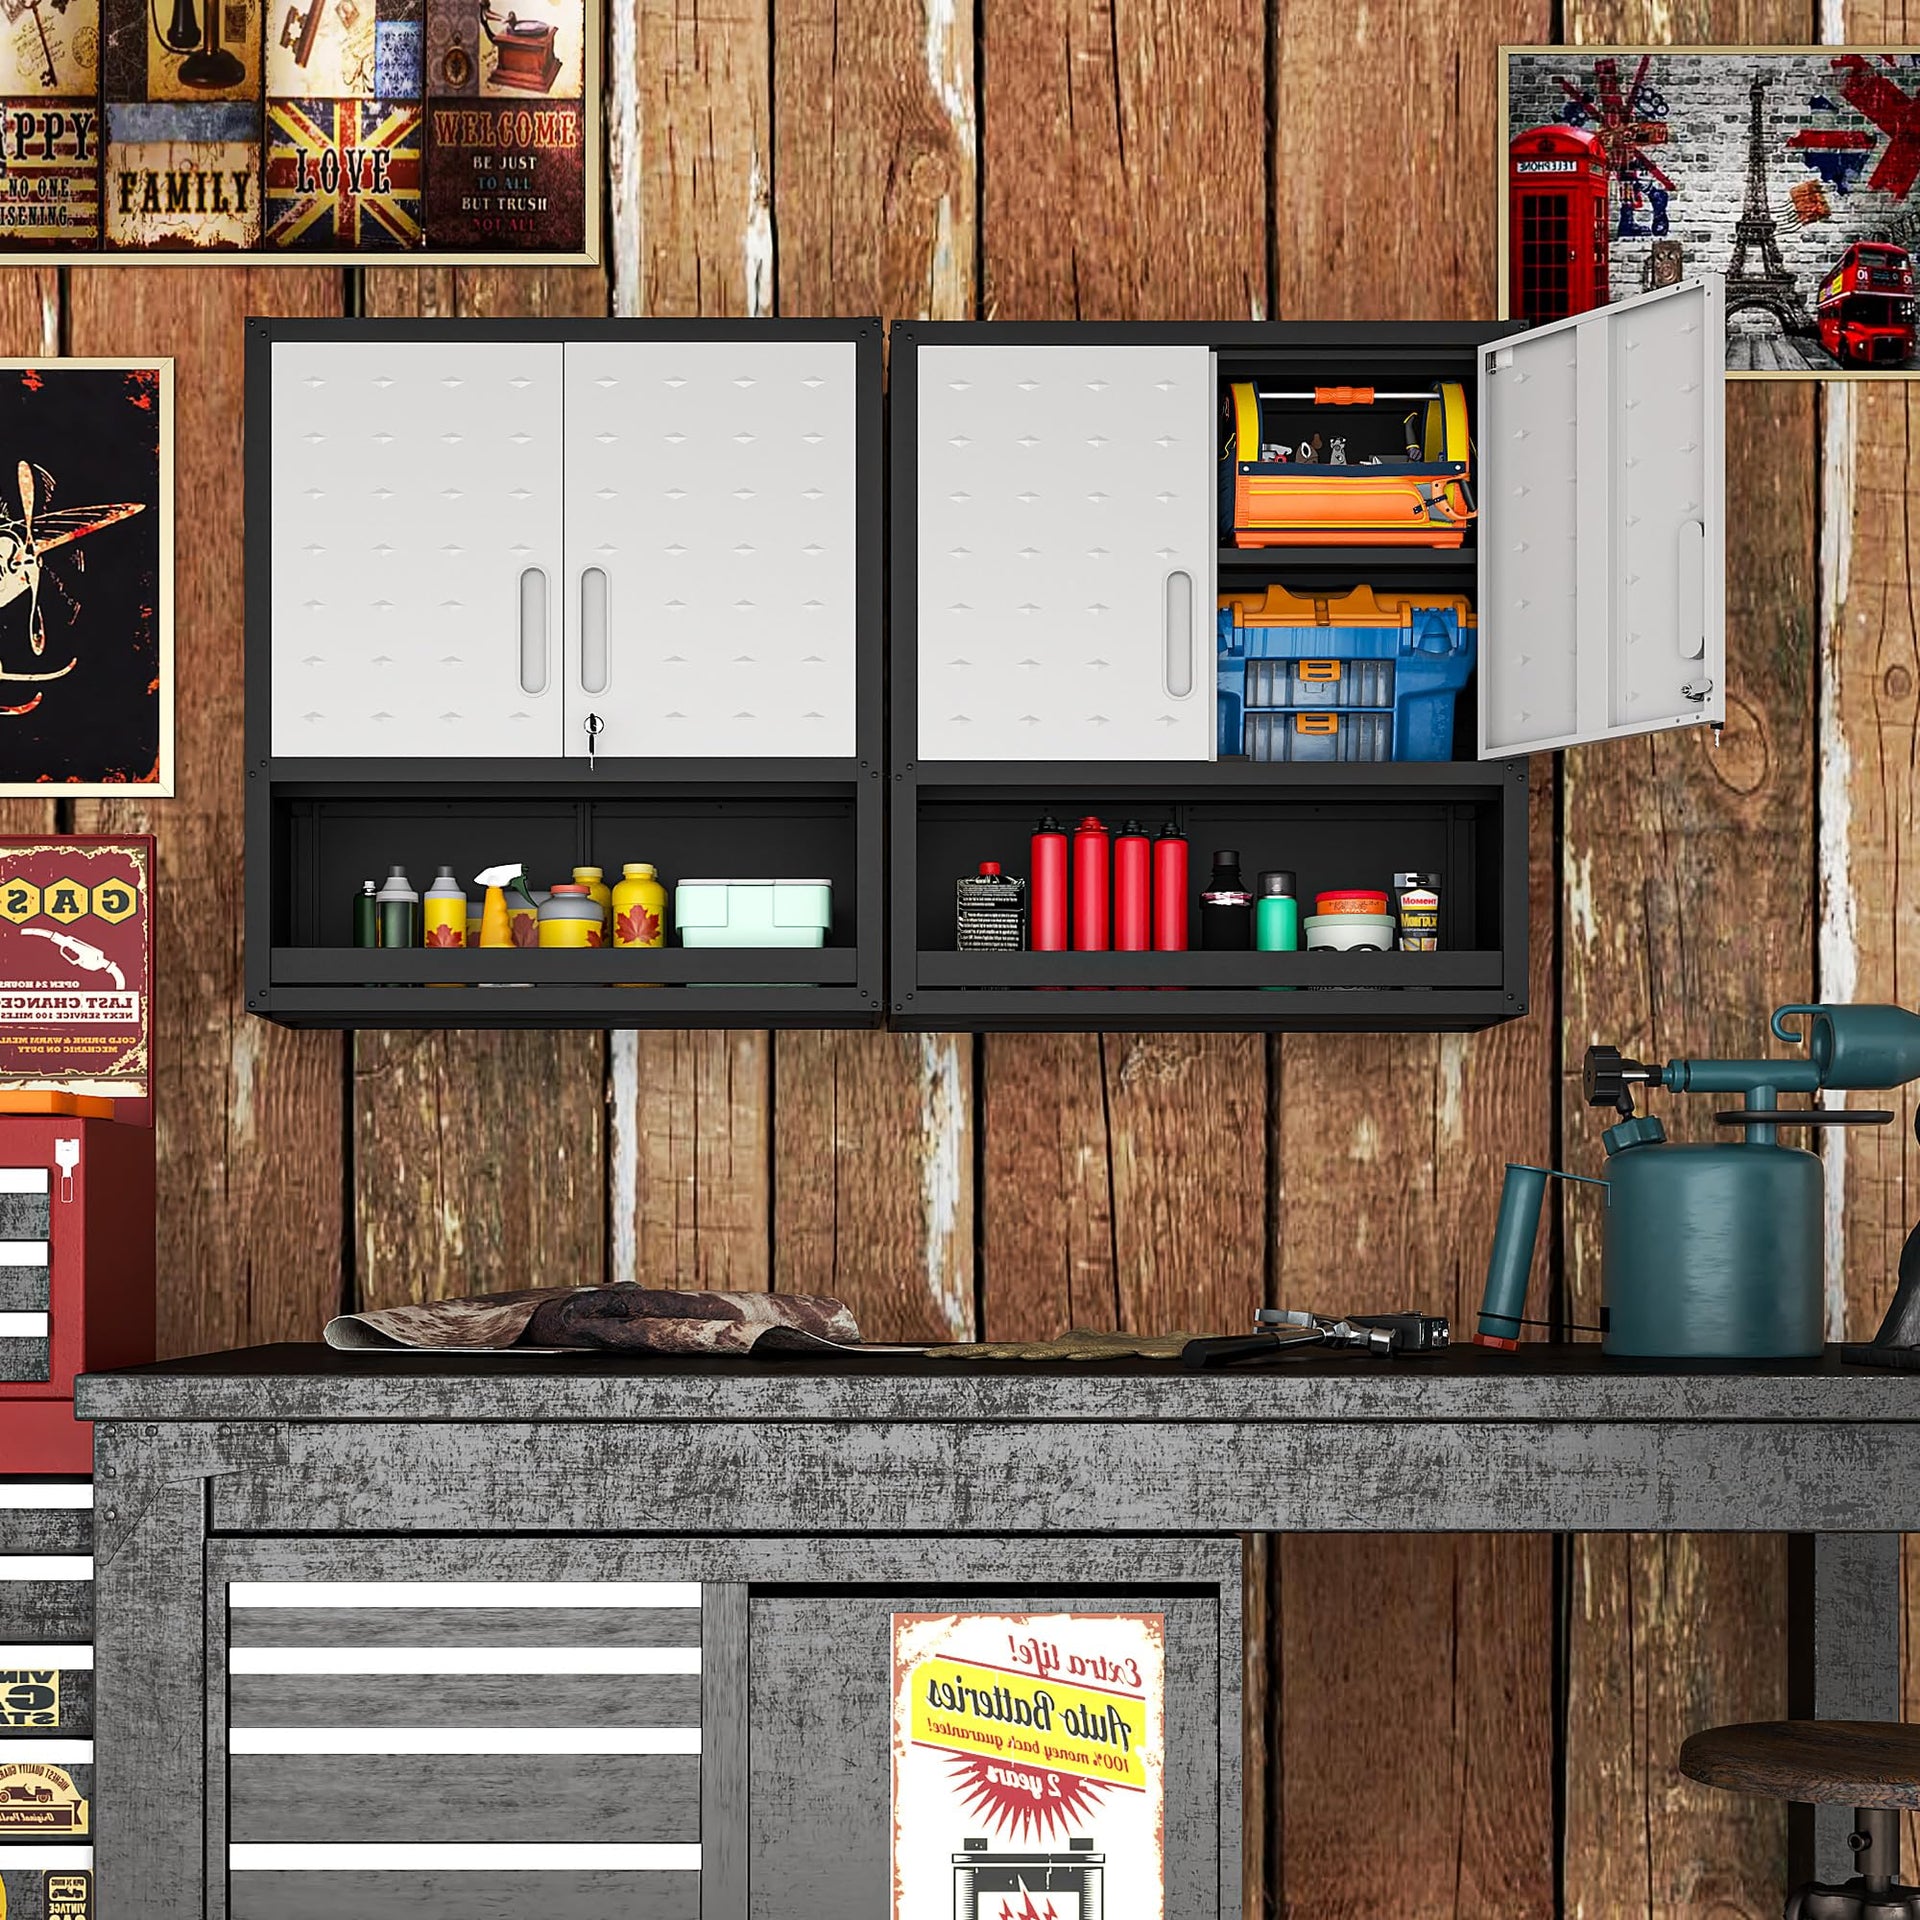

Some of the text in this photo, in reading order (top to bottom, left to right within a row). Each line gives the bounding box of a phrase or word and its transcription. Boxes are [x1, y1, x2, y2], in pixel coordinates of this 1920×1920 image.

[0, 112, 94, 161] PPY
[434, 111, 577, 148] WELCOME
[294, 147, 391, 195] LOVE
[473, 156, 537, 170] BE JUST
[8, 178, 29, 198] NO
[118, 170, 250, 214] FAMILY
[478, 176, 531, 190] TO ALL
[461, 197, 490, 211] BUT
[509, 218, 536, 232] ALL
